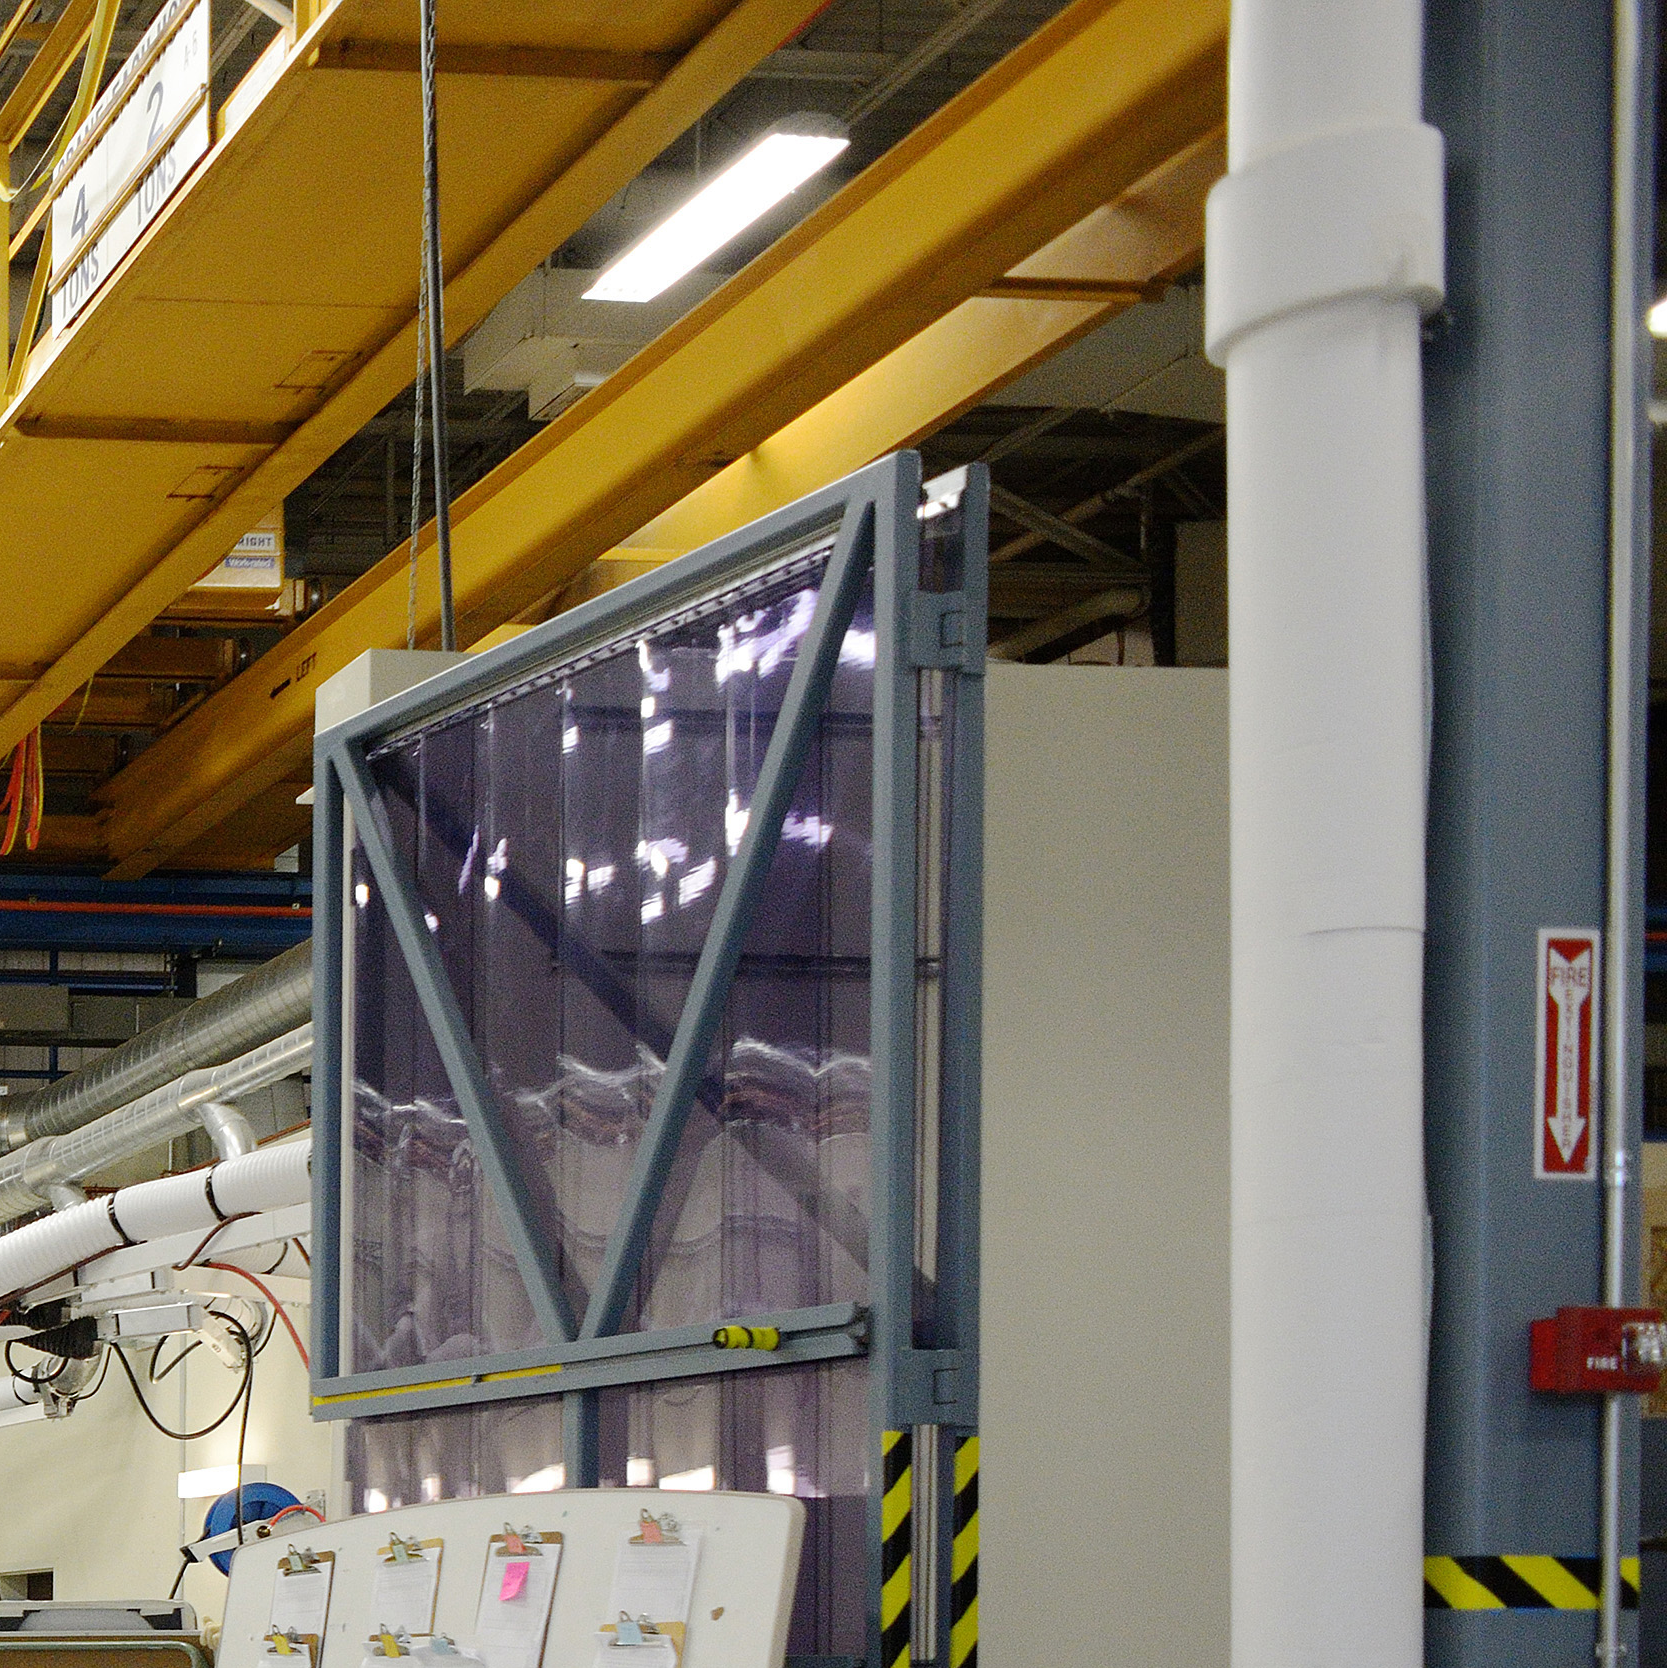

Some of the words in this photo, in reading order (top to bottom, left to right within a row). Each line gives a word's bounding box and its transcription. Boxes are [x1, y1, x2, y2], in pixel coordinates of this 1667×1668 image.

[146, 80, 164, 149] 2
[70, 184, 90, 239] 4
[136, 150, 177, 227] TONS
[61, 245, 100, 319] TONS
[236, 536, 272, 547] RIGHT
[296, 651, 317, 682] LEFT
[1551, 966, 1590, 988] FIRE
[1561, 988, 1576, 1150] EXTINGUISHER
